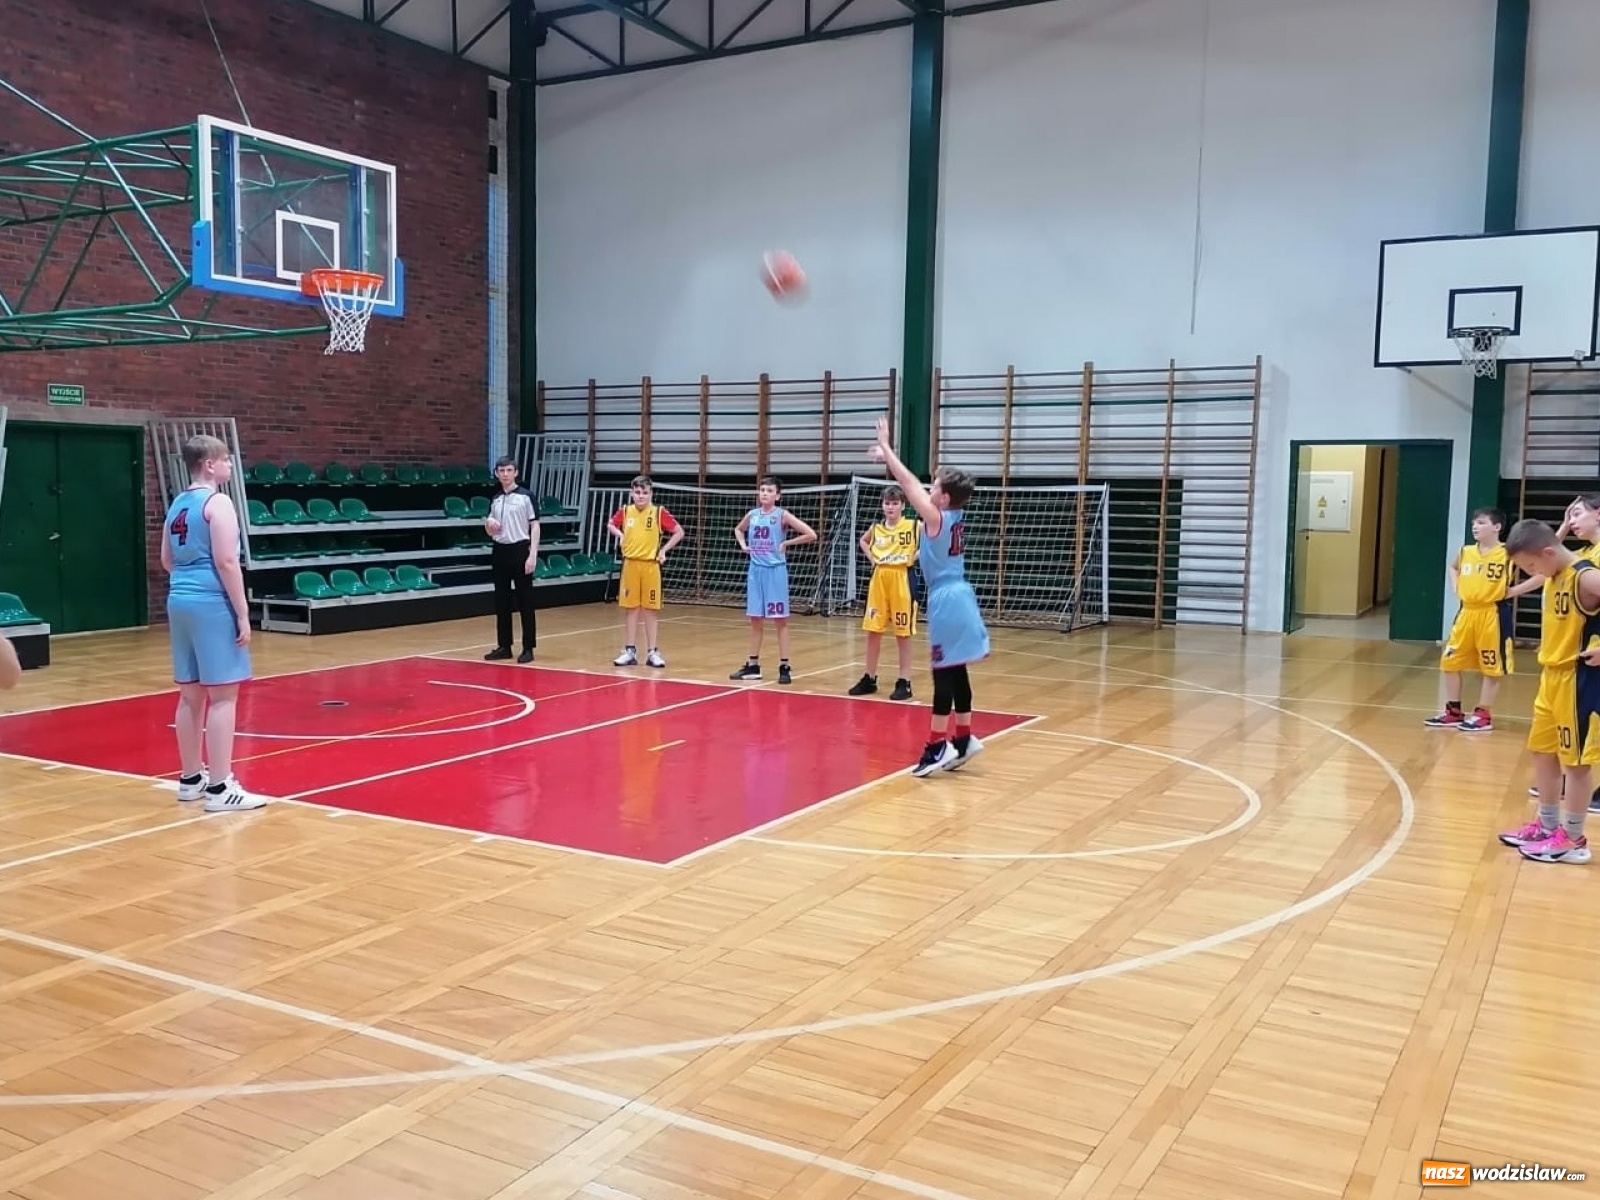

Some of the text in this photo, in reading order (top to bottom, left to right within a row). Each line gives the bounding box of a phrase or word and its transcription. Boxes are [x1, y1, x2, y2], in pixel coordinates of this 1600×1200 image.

[170, 507, 189, 546] 4
[646, 517, 652, 528] 8
[753, 525, 770, 539] 20
[899, 531, 911, 545] 50
[1486, 563, 1504, 579] 53
[649, 589, 656, 601] 8
[767, 602, 784, 615] 20
[1555, 591, 1569, 614] 30
[895, 611, 907, 626] 50
[1481, 649, 1496, 665] 53
